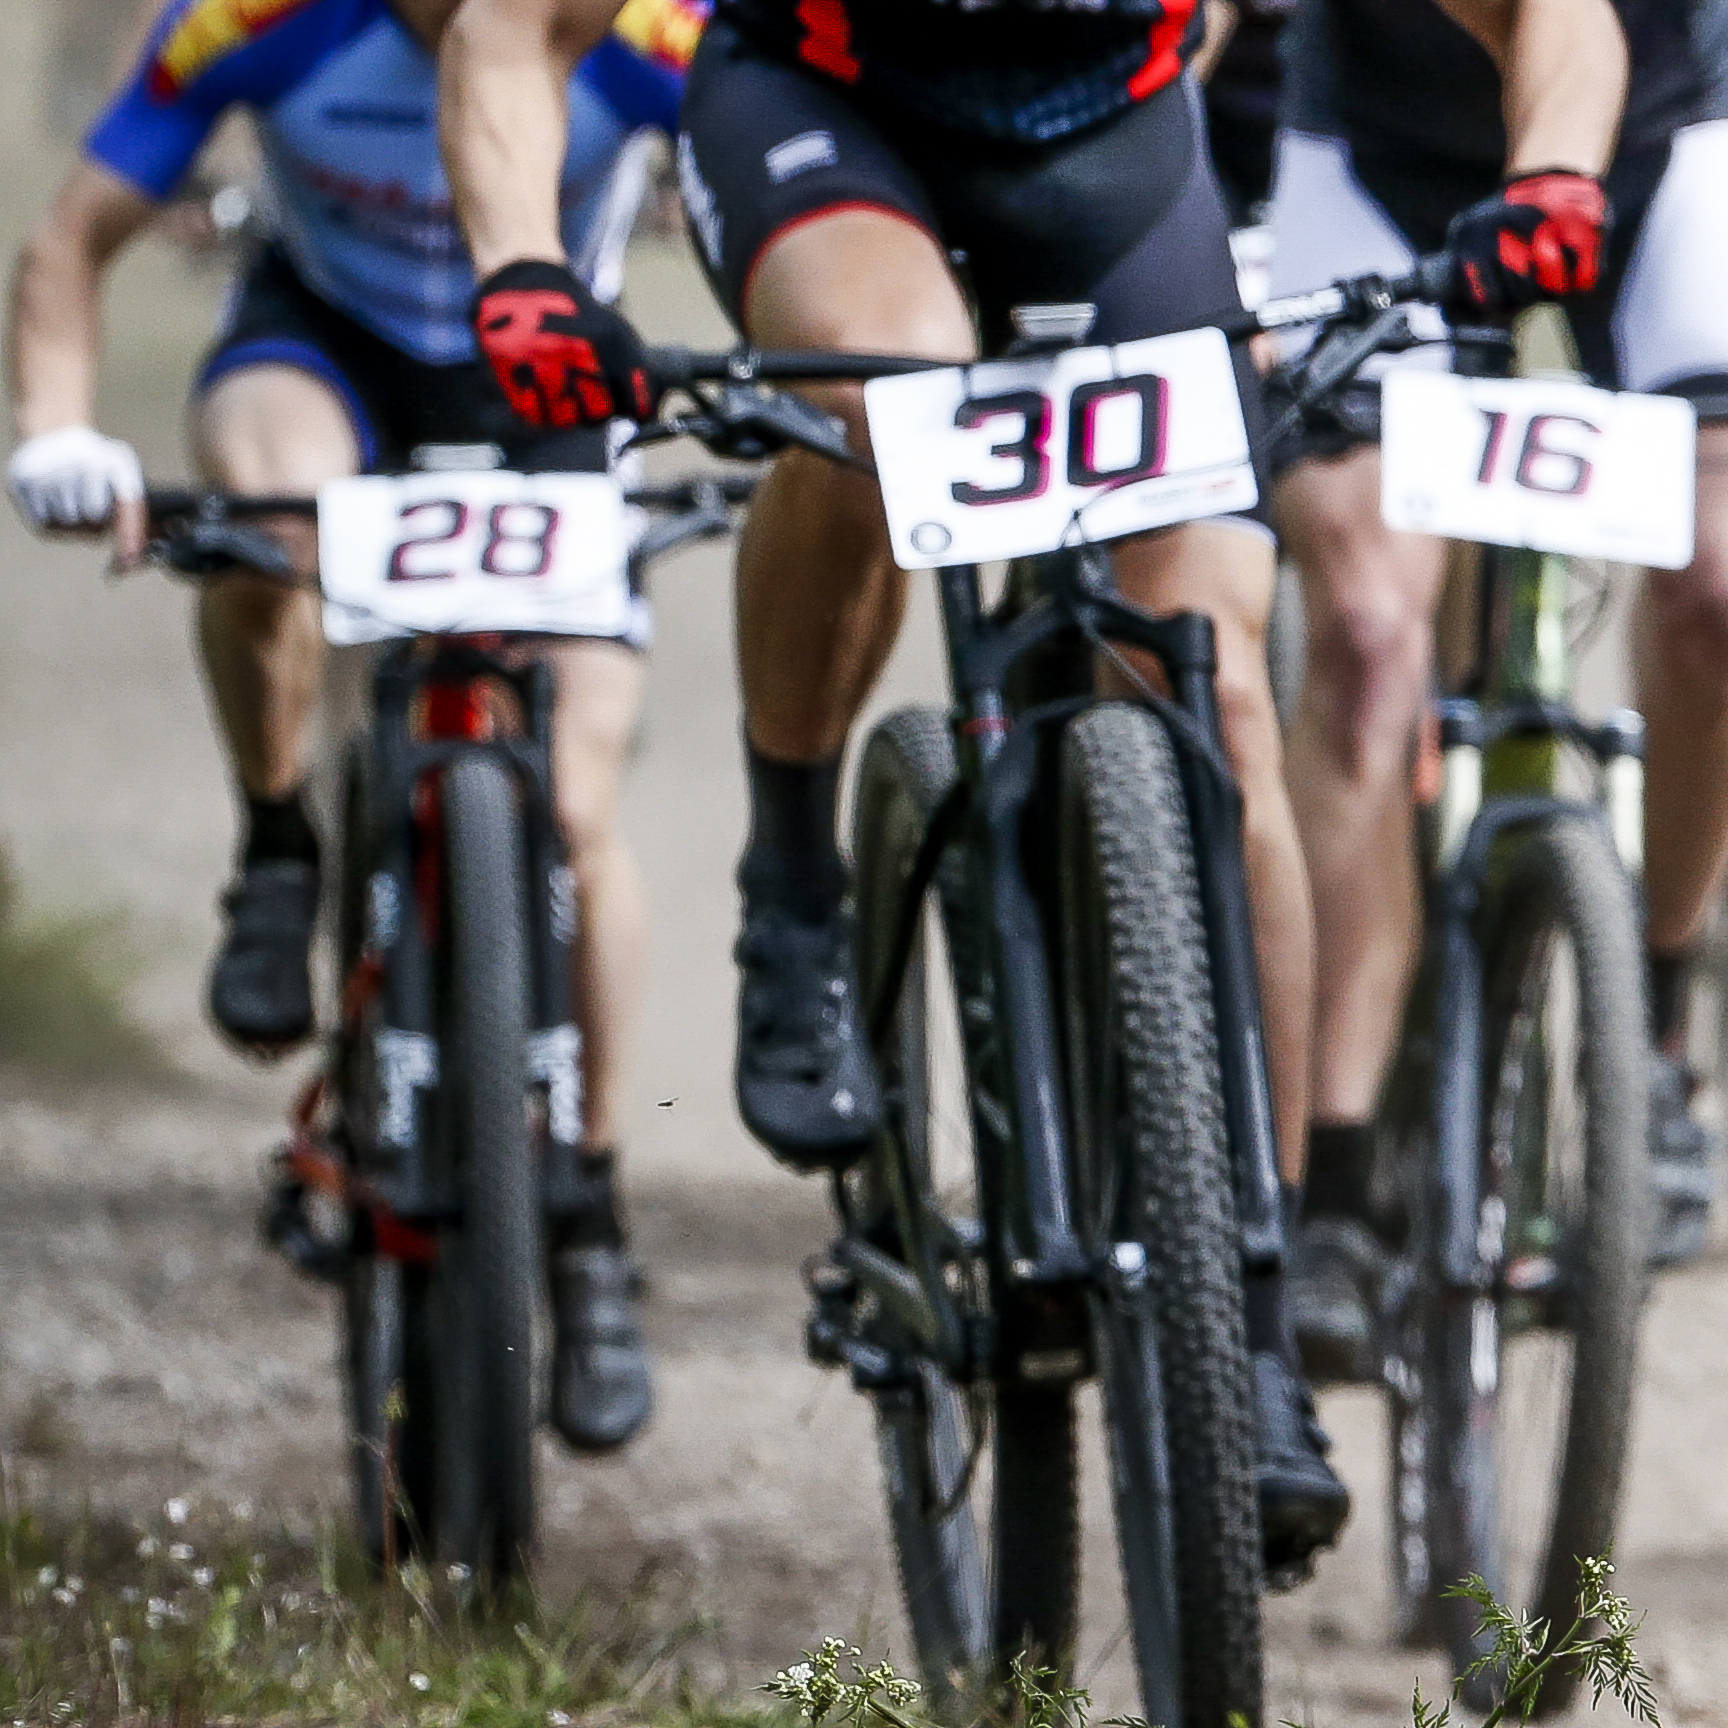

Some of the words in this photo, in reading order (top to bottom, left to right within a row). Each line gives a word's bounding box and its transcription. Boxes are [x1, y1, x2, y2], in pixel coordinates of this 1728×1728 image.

[951, 372, 1168, 507] 30
[1473, 407, 1603, 496] 16
[387, 500, 561, 584] 28
